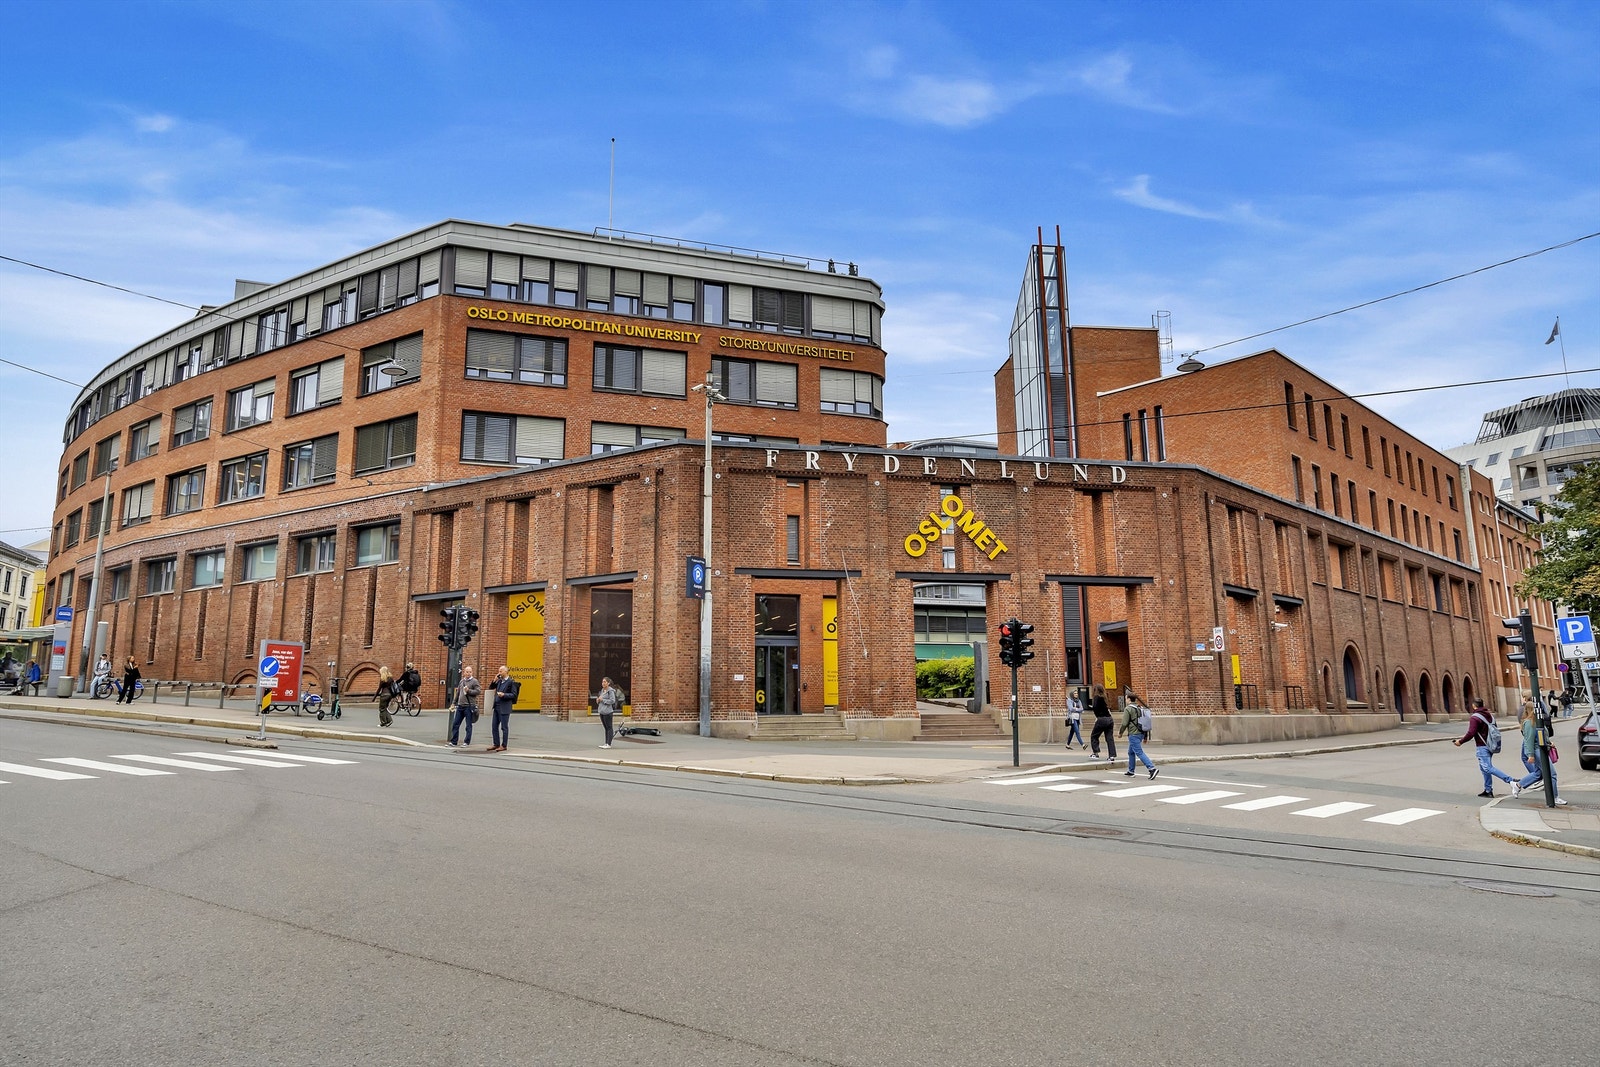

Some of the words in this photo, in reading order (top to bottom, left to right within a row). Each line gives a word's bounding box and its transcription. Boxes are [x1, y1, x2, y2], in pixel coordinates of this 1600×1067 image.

[467, 306, 509, 321] OSLO
[512, 312, 621, 335] METROPOLITAN
[625, 325, 702, 344] UNIVERSITY
[719, 335, 856, 362] STORBYUNIVERSITETET
[765, 449, 1127, 484] FRYDENLUND
[904, 494, 1009, 561] OSLOMET
[1566, 620, 1584, 641] P
[756, 689, 766, 704] 6
